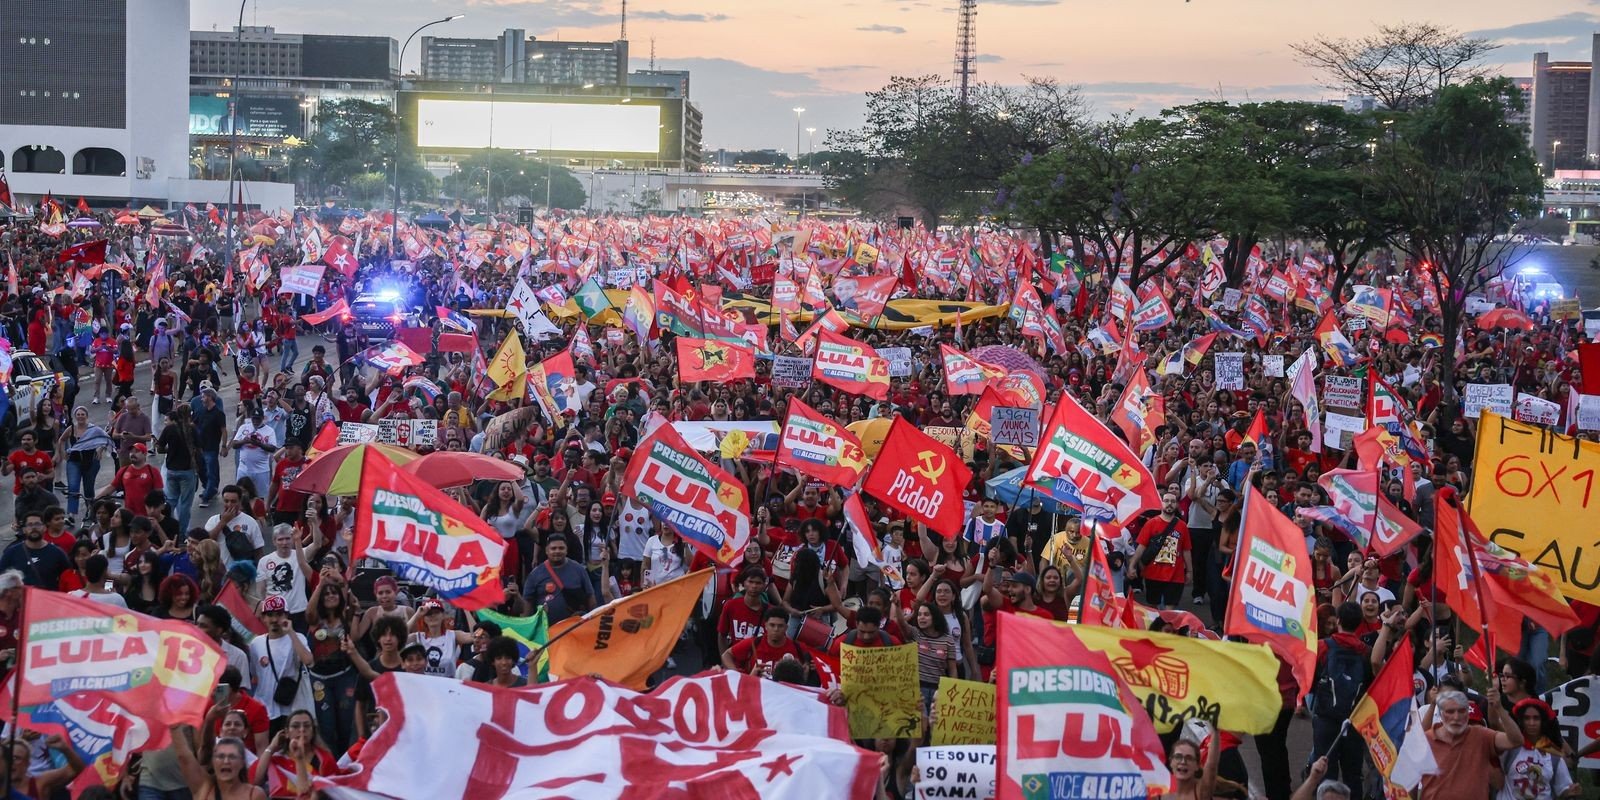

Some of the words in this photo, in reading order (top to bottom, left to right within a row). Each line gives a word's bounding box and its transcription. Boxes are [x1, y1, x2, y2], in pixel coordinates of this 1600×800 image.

[818, 352, 864, 368] LULA
[871, 360, 889, 376] 13
[997, 410, 1032, 422] 1964
[786, 426, 836, 450] LULA
[843, 443, 864, 462] 13
[994, 431, 1034, 445] MAIS
[887, 468, 944, 520] PCdoB
[1056, 478, 1072, 494] VICE
[642, 462, 738, 539] LULA
[373, 519, 488, 570] LULA
[1245, 560, 1296, 608] LULA
[30, 636, 148, 669] LULA
[163, 636, 206, 674] 13
[70, 673, 128, 690] ALCKMIN
[1012, 669, 1119, 700] PRESIDENT
[957, 772, 978, 784] NA
[1051, 774, 1082, 800] VICE
[926, 786, 977, 799] CAMA
